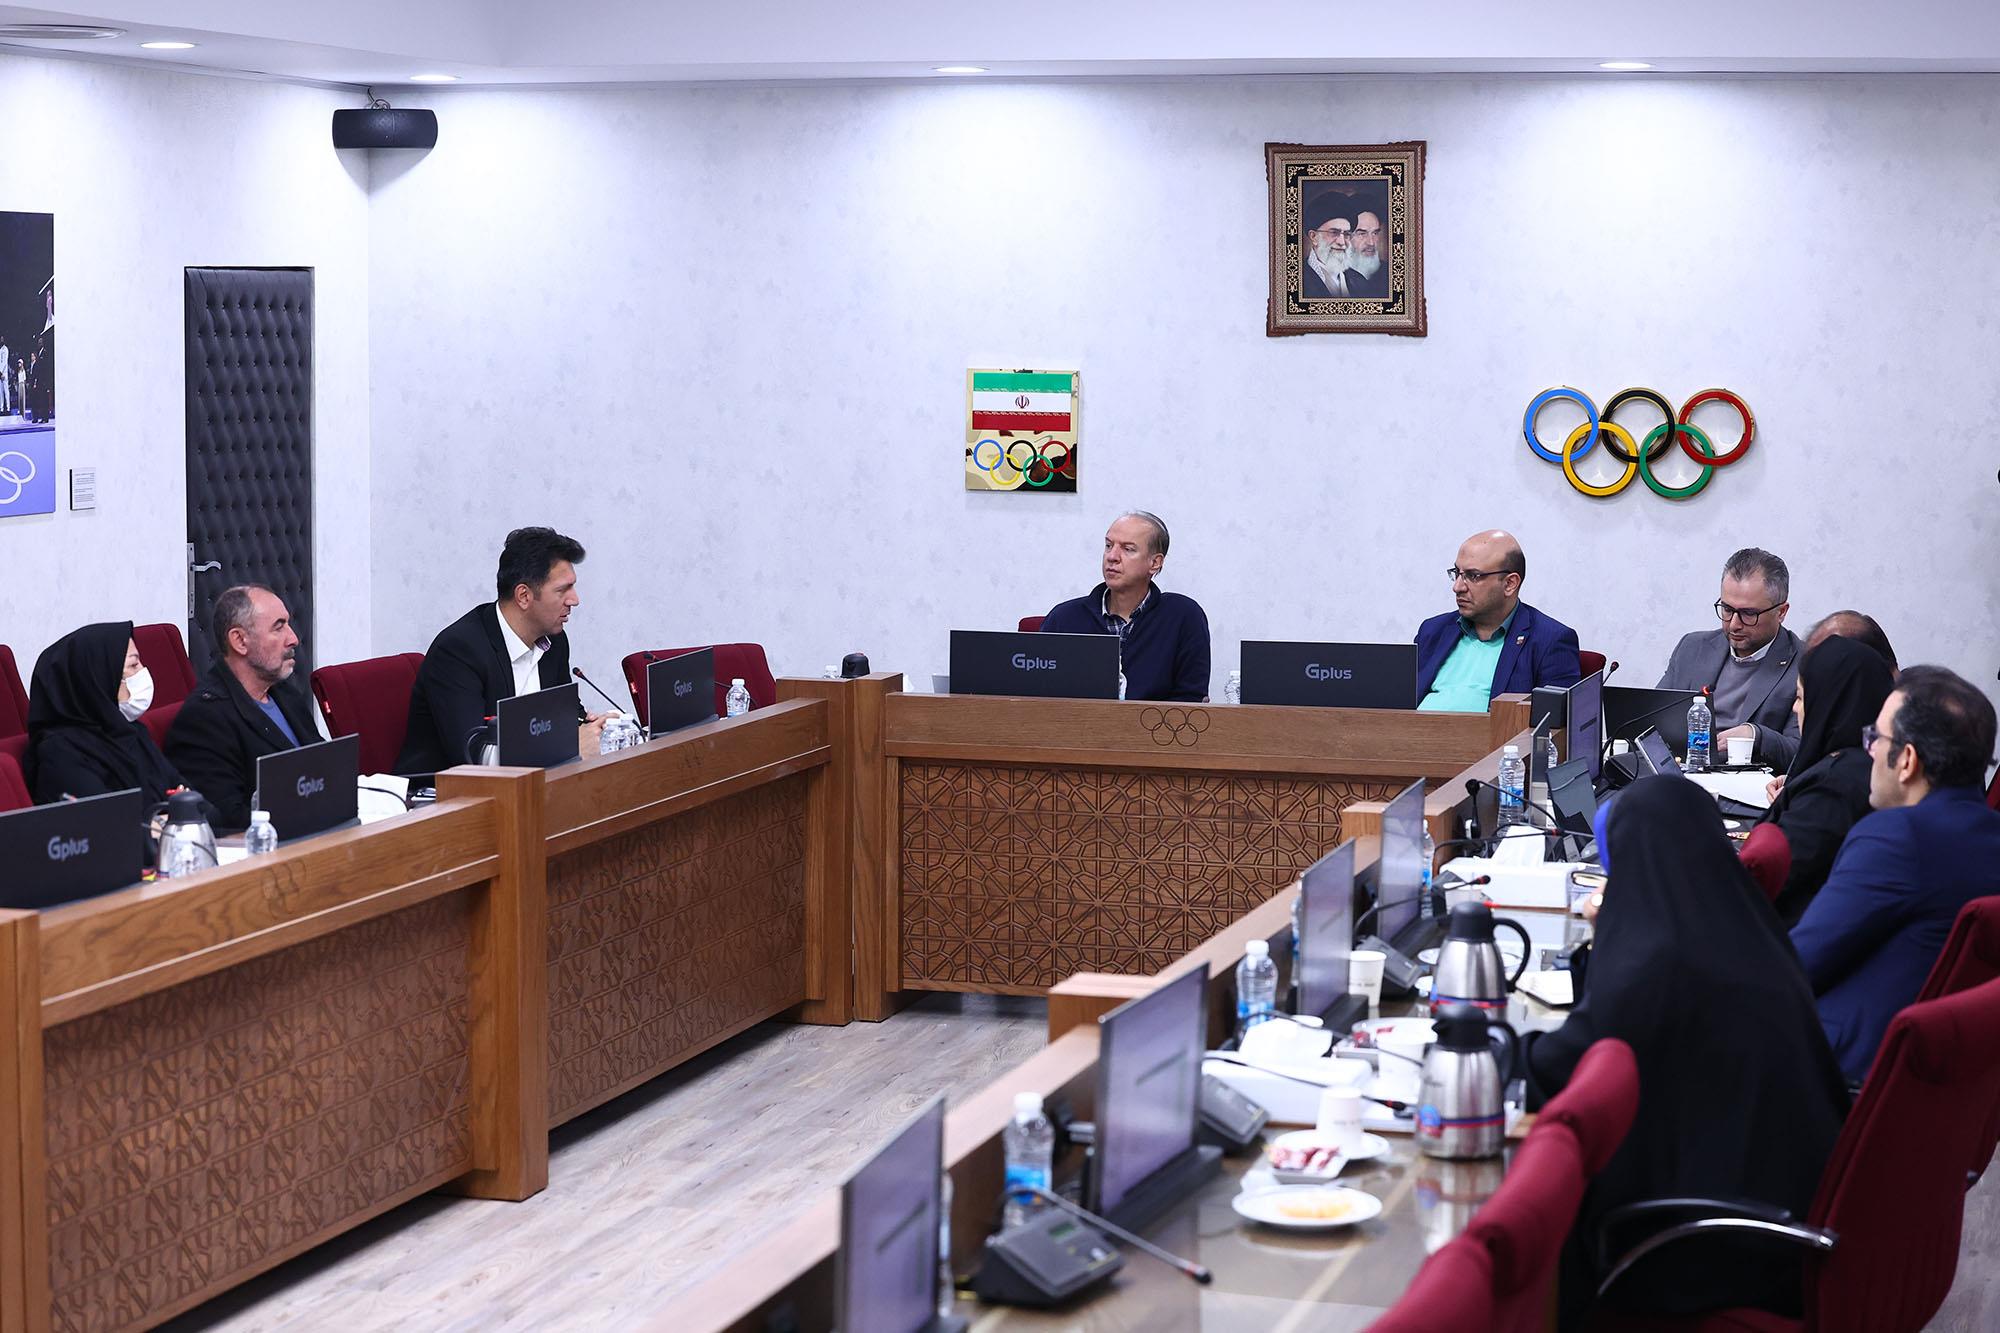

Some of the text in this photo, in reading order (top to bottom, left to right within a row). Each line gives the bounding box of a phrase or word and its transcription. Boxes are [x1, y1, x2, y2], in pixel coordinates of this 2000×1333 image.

[1012, 653, 1057, 671] Gplus
[1305, 664, 1353, 681] Gplus
[674, 679, 692, 697] Gplus
[528, 717, 551, 737] Gplus
[297, 776, 325, 798] Gplus
[48, 836, 89, 862] Gplus
